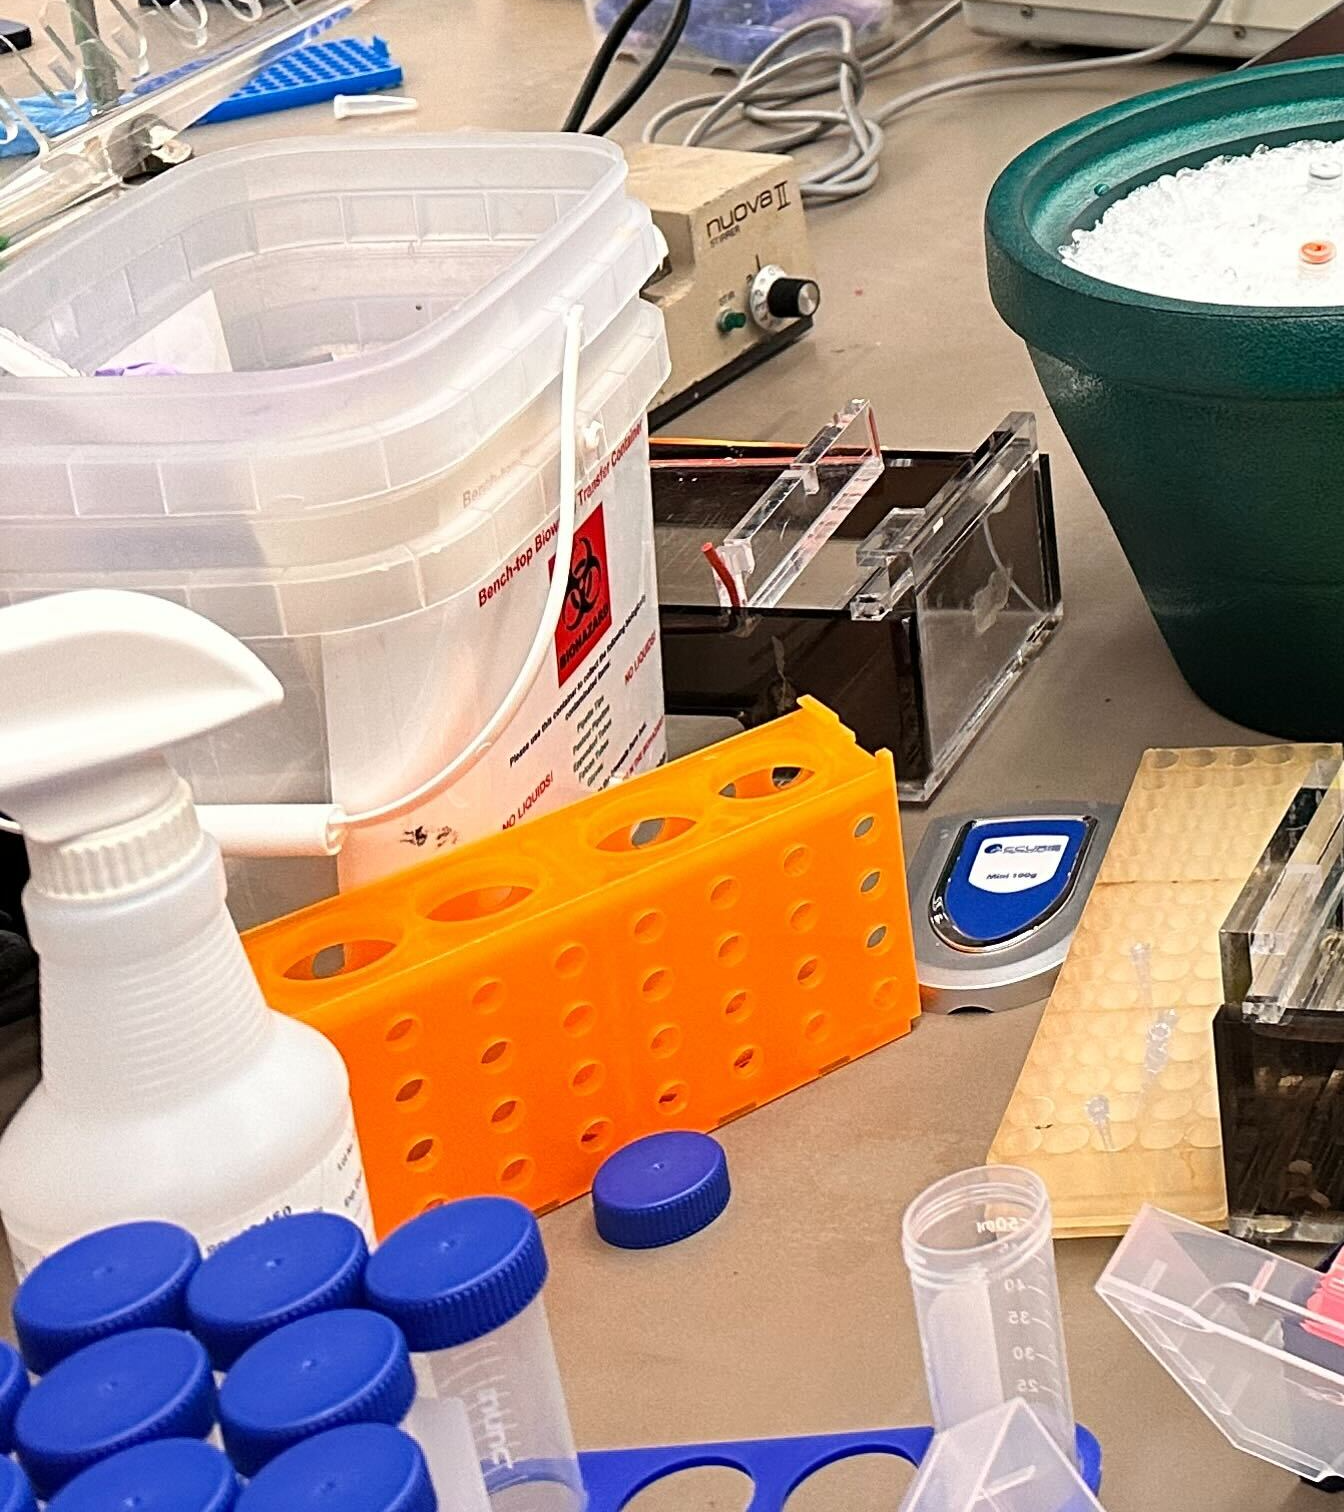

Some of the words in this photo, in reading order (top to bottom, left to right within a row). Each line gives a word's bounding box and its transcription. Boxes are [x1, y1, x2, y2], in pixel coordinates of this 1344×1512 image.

[706, 190, 773, 238] nuova
[774, 180, 791, 211] II
[478, 547, 534, 607] Bench-top
[535, 520, 560, 553] Biow
[577, 462, 610, 506] Transfer
[611, 419, 643, 467] Container
[518, 770, 554, 819] LIQUIDS!
